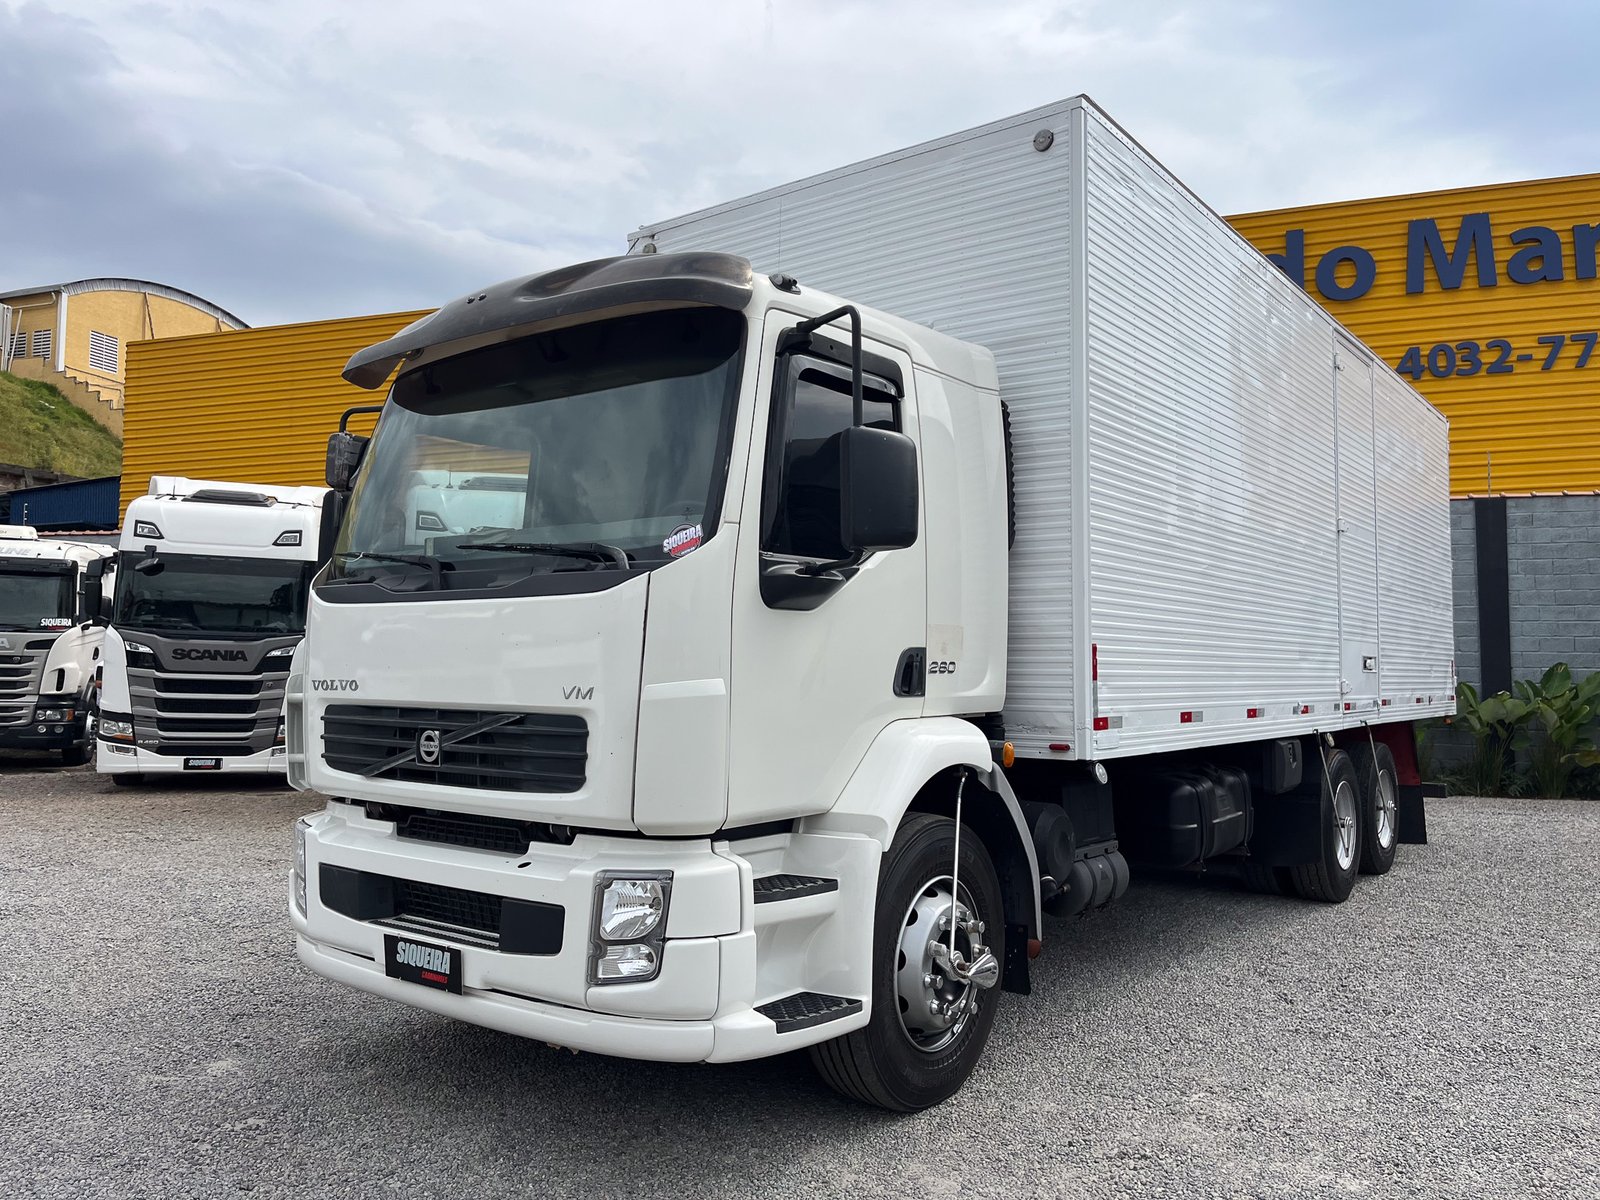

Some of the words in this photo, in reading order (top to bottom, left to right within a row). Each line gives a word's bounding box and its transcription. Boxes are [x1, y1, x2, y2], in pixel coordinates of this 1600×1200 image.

[1406, 211, 1600, 294] Mar
[1395, 331, 1598, 380] 4032-77
[662, 523, 703, 552] SIQUEIRA
[40, 618, 72, 627] SIQUEIRA
[171, 648, 248, 661] SCANIA
[928, 661, 956, 674] 260
[311, 679, 359, 691] VOLVO
[562, 685, 594, 700] VM
[396, 941, 451, 975] SIQUEIRA
